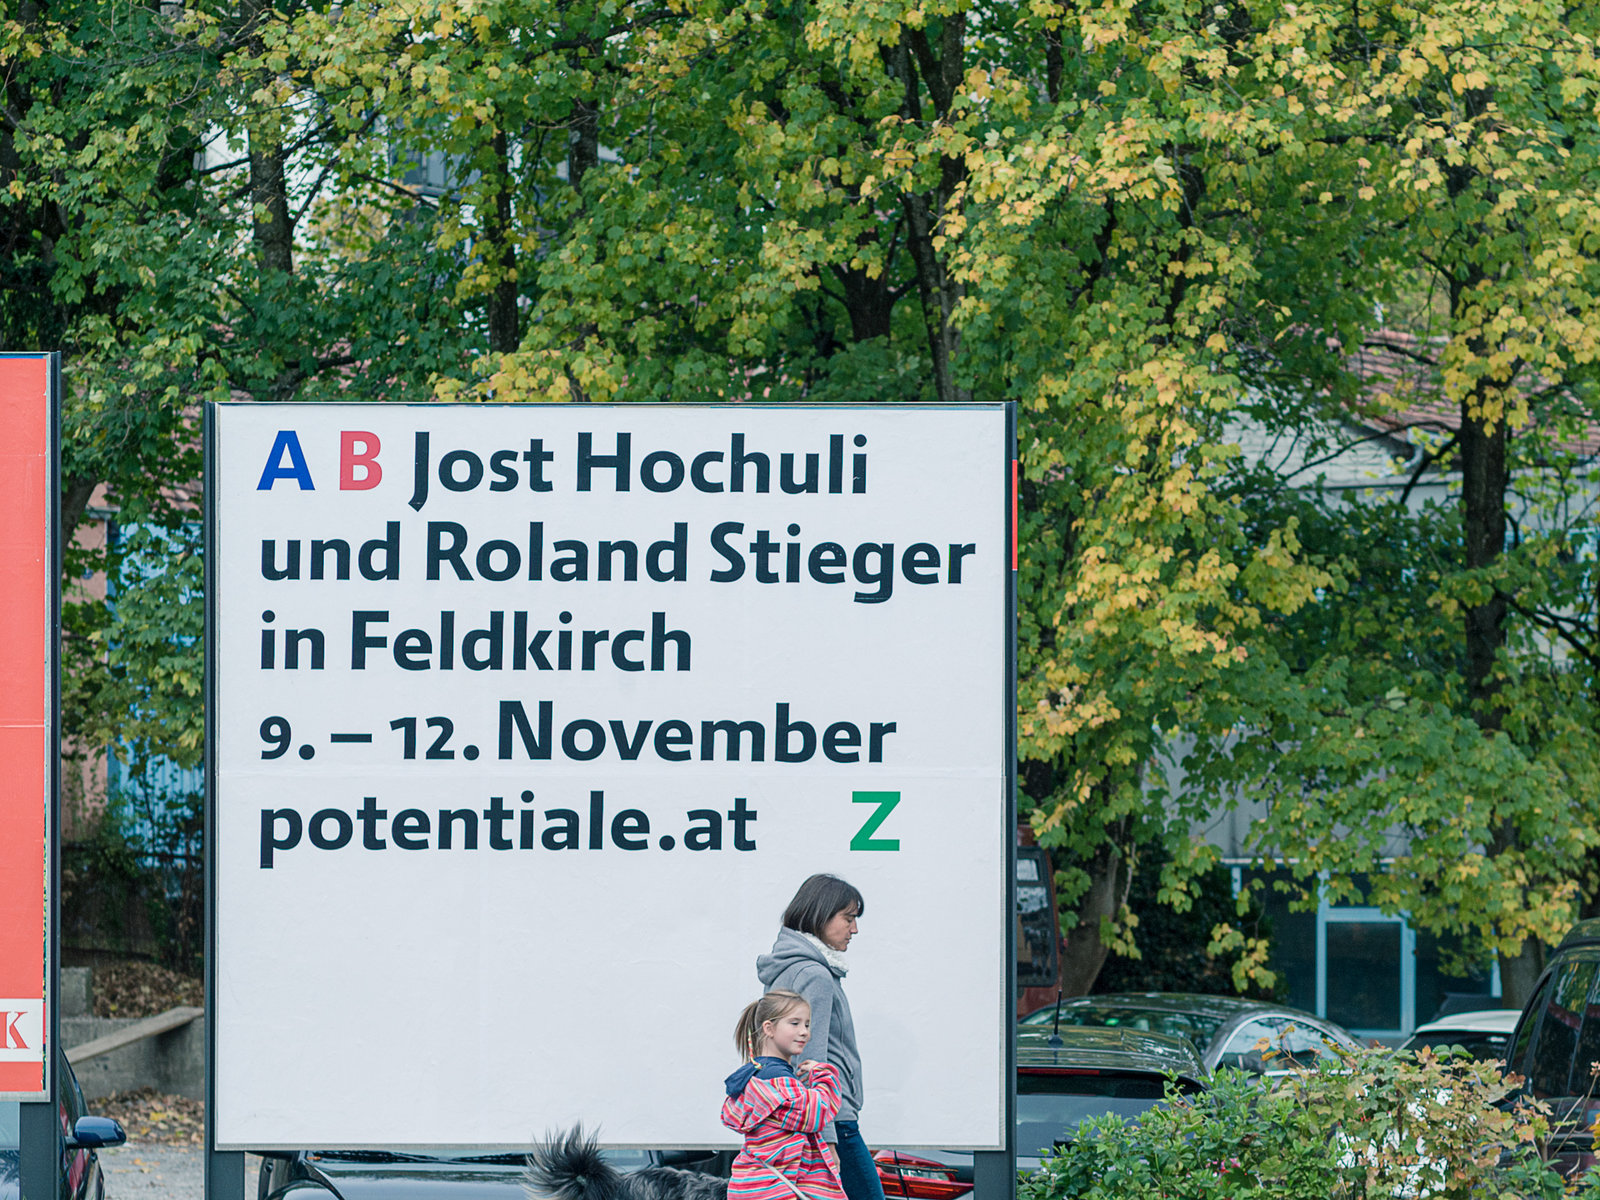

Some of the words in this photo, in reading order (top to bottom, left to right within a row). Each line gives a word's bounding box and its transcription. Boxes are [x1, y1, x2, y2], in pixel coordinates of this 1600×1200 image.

[256, 431, 315, 490] A
[339, 431, 383, 490] B
[407, 432, 555, 512] Jost
[575, 432, 868, 495] Hochuli
[261, 521, 401, 582] und
[426, 521, 689, 582] Roland
[709, 522, 977, 604] Stieger
[260, 610, 325, 670] in
[350, 611, 692, 672] Feldkirch
[259, 715, 316, 761] 9.
[388, 715, 480, 762] 12.
[497, 700, 897, 764] November
[259, 790, 758, 869] potentiale.at
[849, 791, 902, 852] Z
